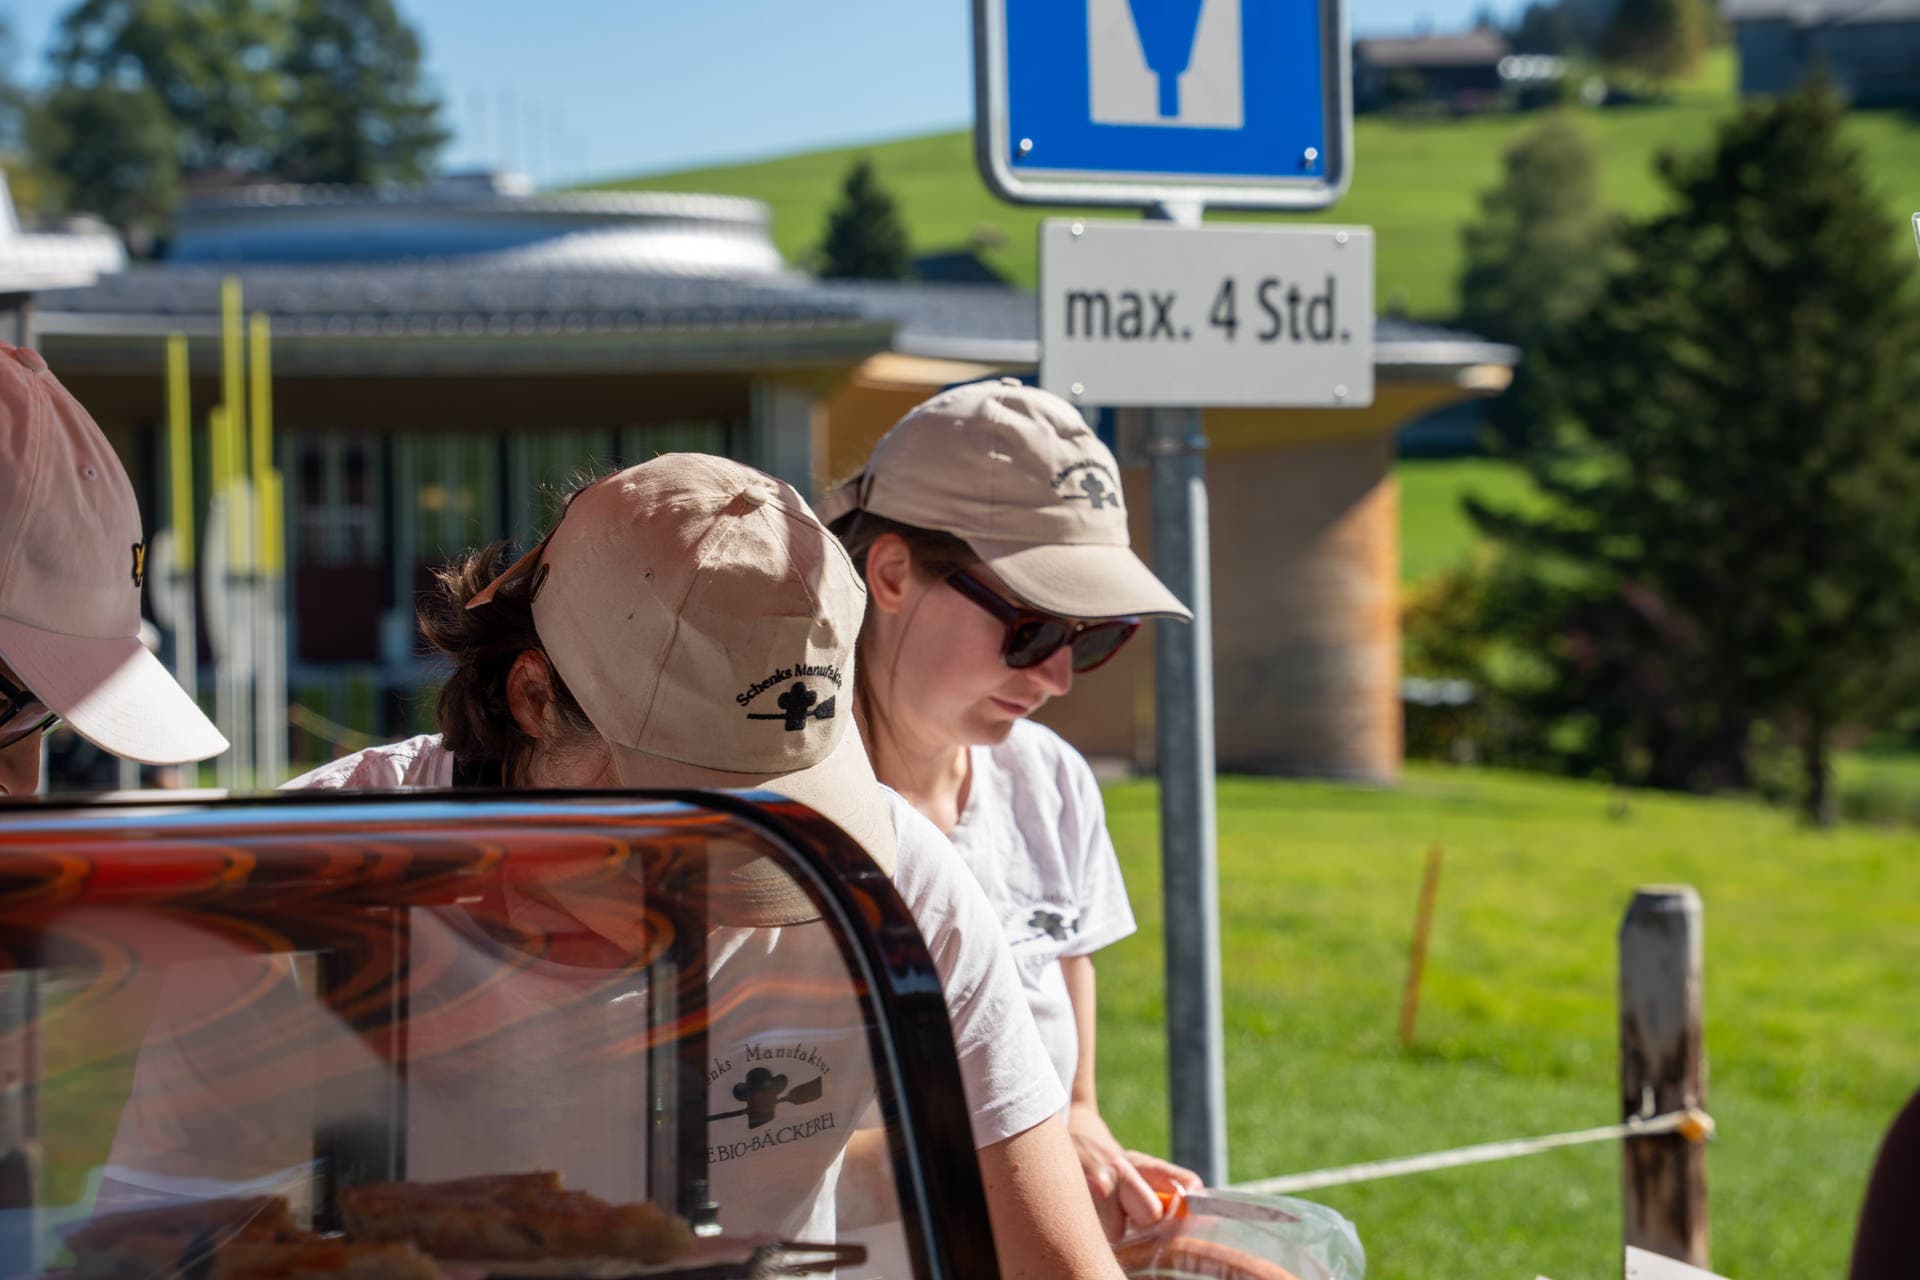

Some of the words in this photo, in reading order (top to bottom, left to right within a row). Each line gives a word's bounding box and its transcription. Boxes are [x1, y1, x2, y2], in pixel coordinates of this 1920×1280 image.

[1064, 289, 1193, 341] max.
[1208, 277, 1240, 341] 4
[1257, 275, 1351, 342] Std.
[736, 668, 793, 707] Schenks
[744, 1042, 831, 1075] Manufaktur
